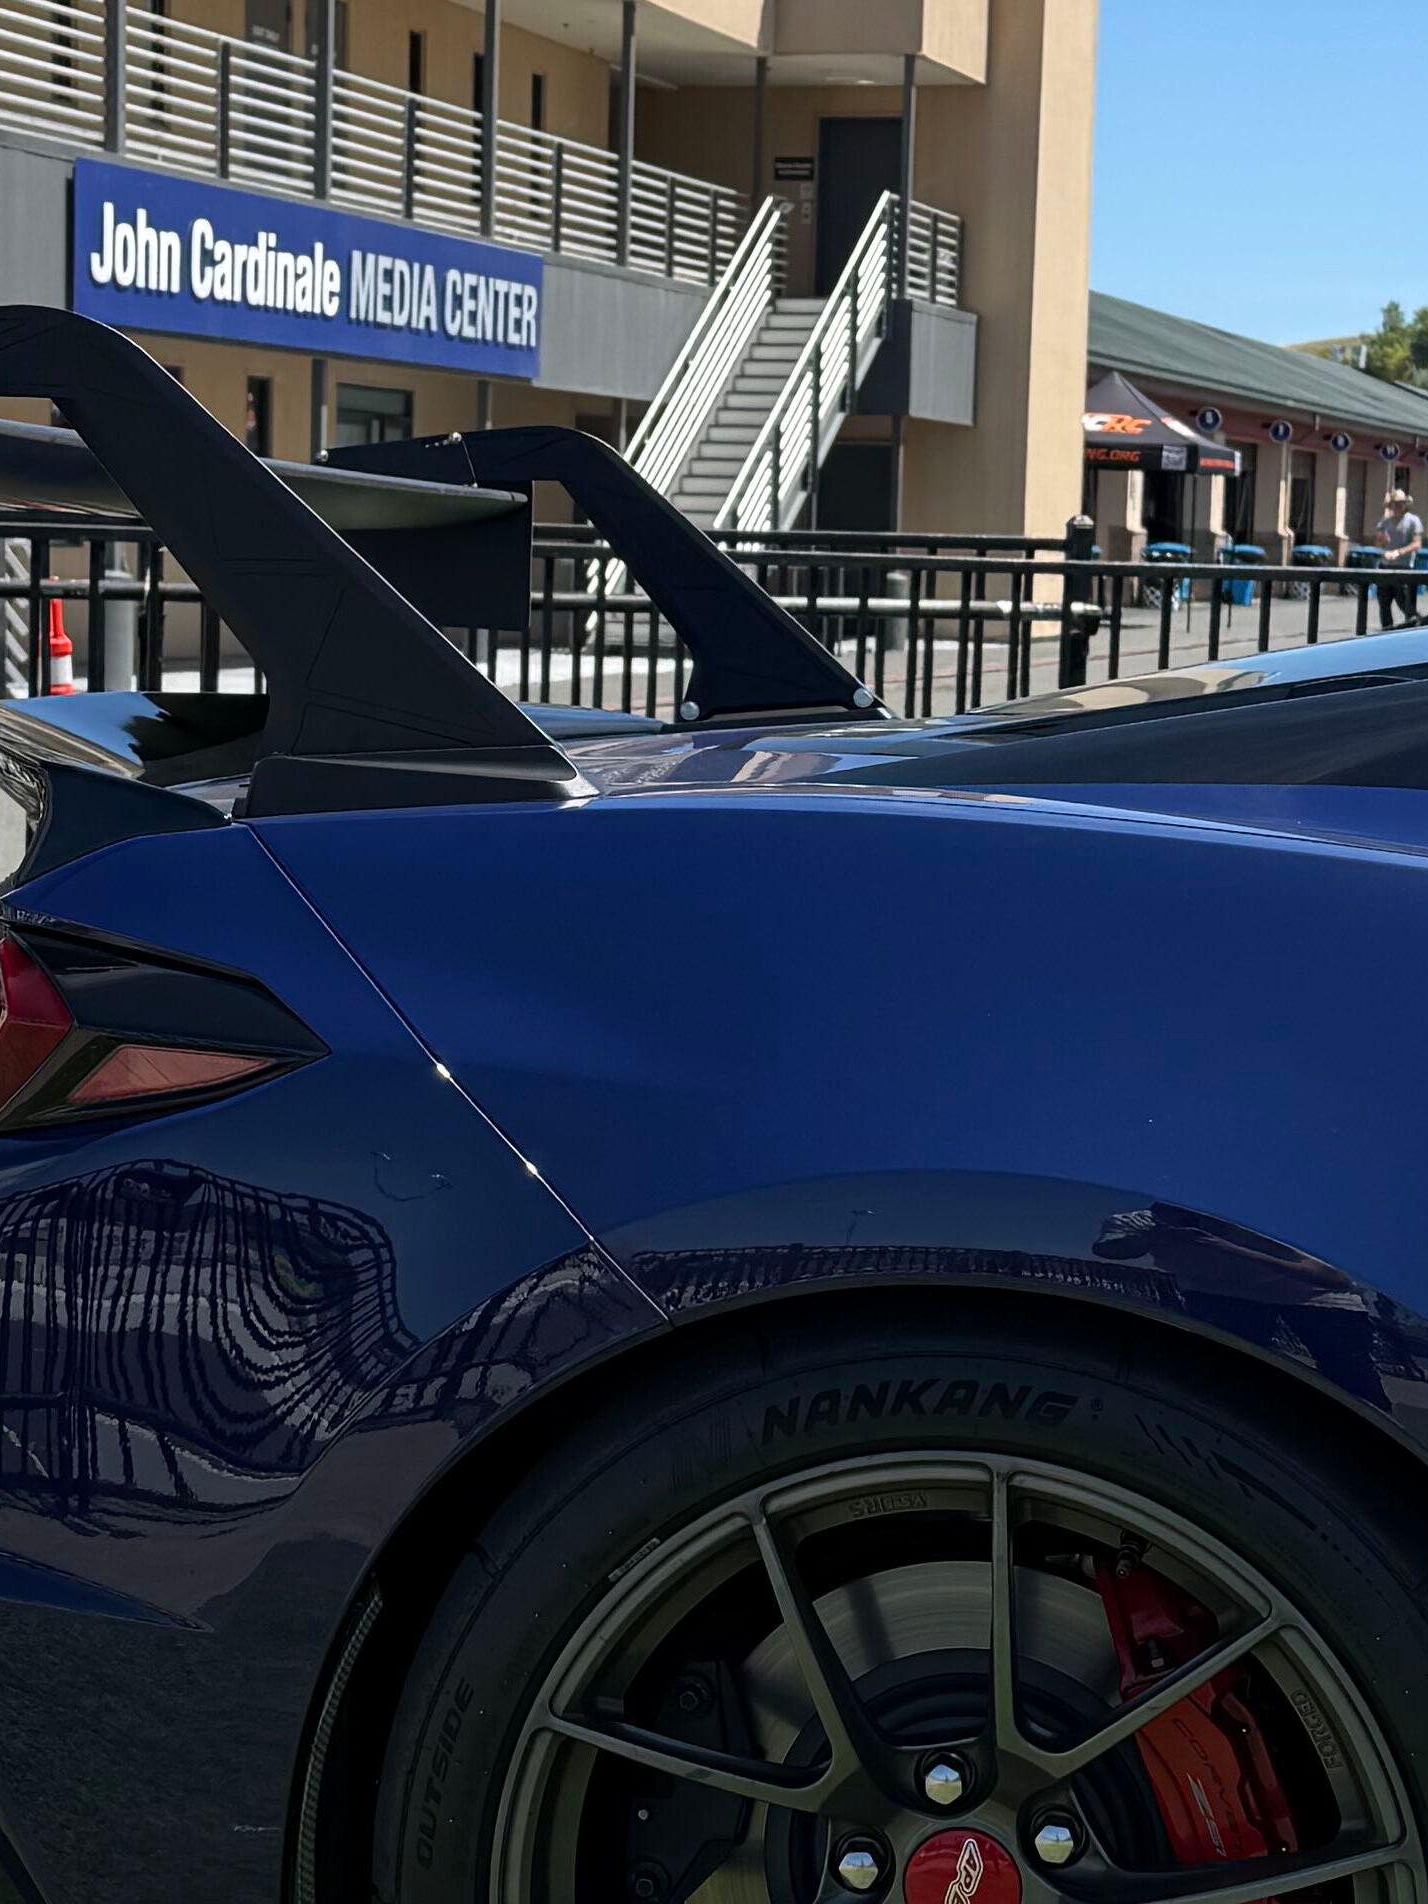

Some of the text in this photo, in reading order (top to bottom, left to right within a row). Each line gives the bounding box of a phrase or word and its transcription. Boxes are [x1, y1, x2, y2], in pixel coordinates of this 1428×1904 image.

[90, 201, 538, 349] John Cardinale MEDIA CENTER
[762, 1378, 1080, 1445] NANKANG
[416, 1677, 475, 1871] OUTSIDE
